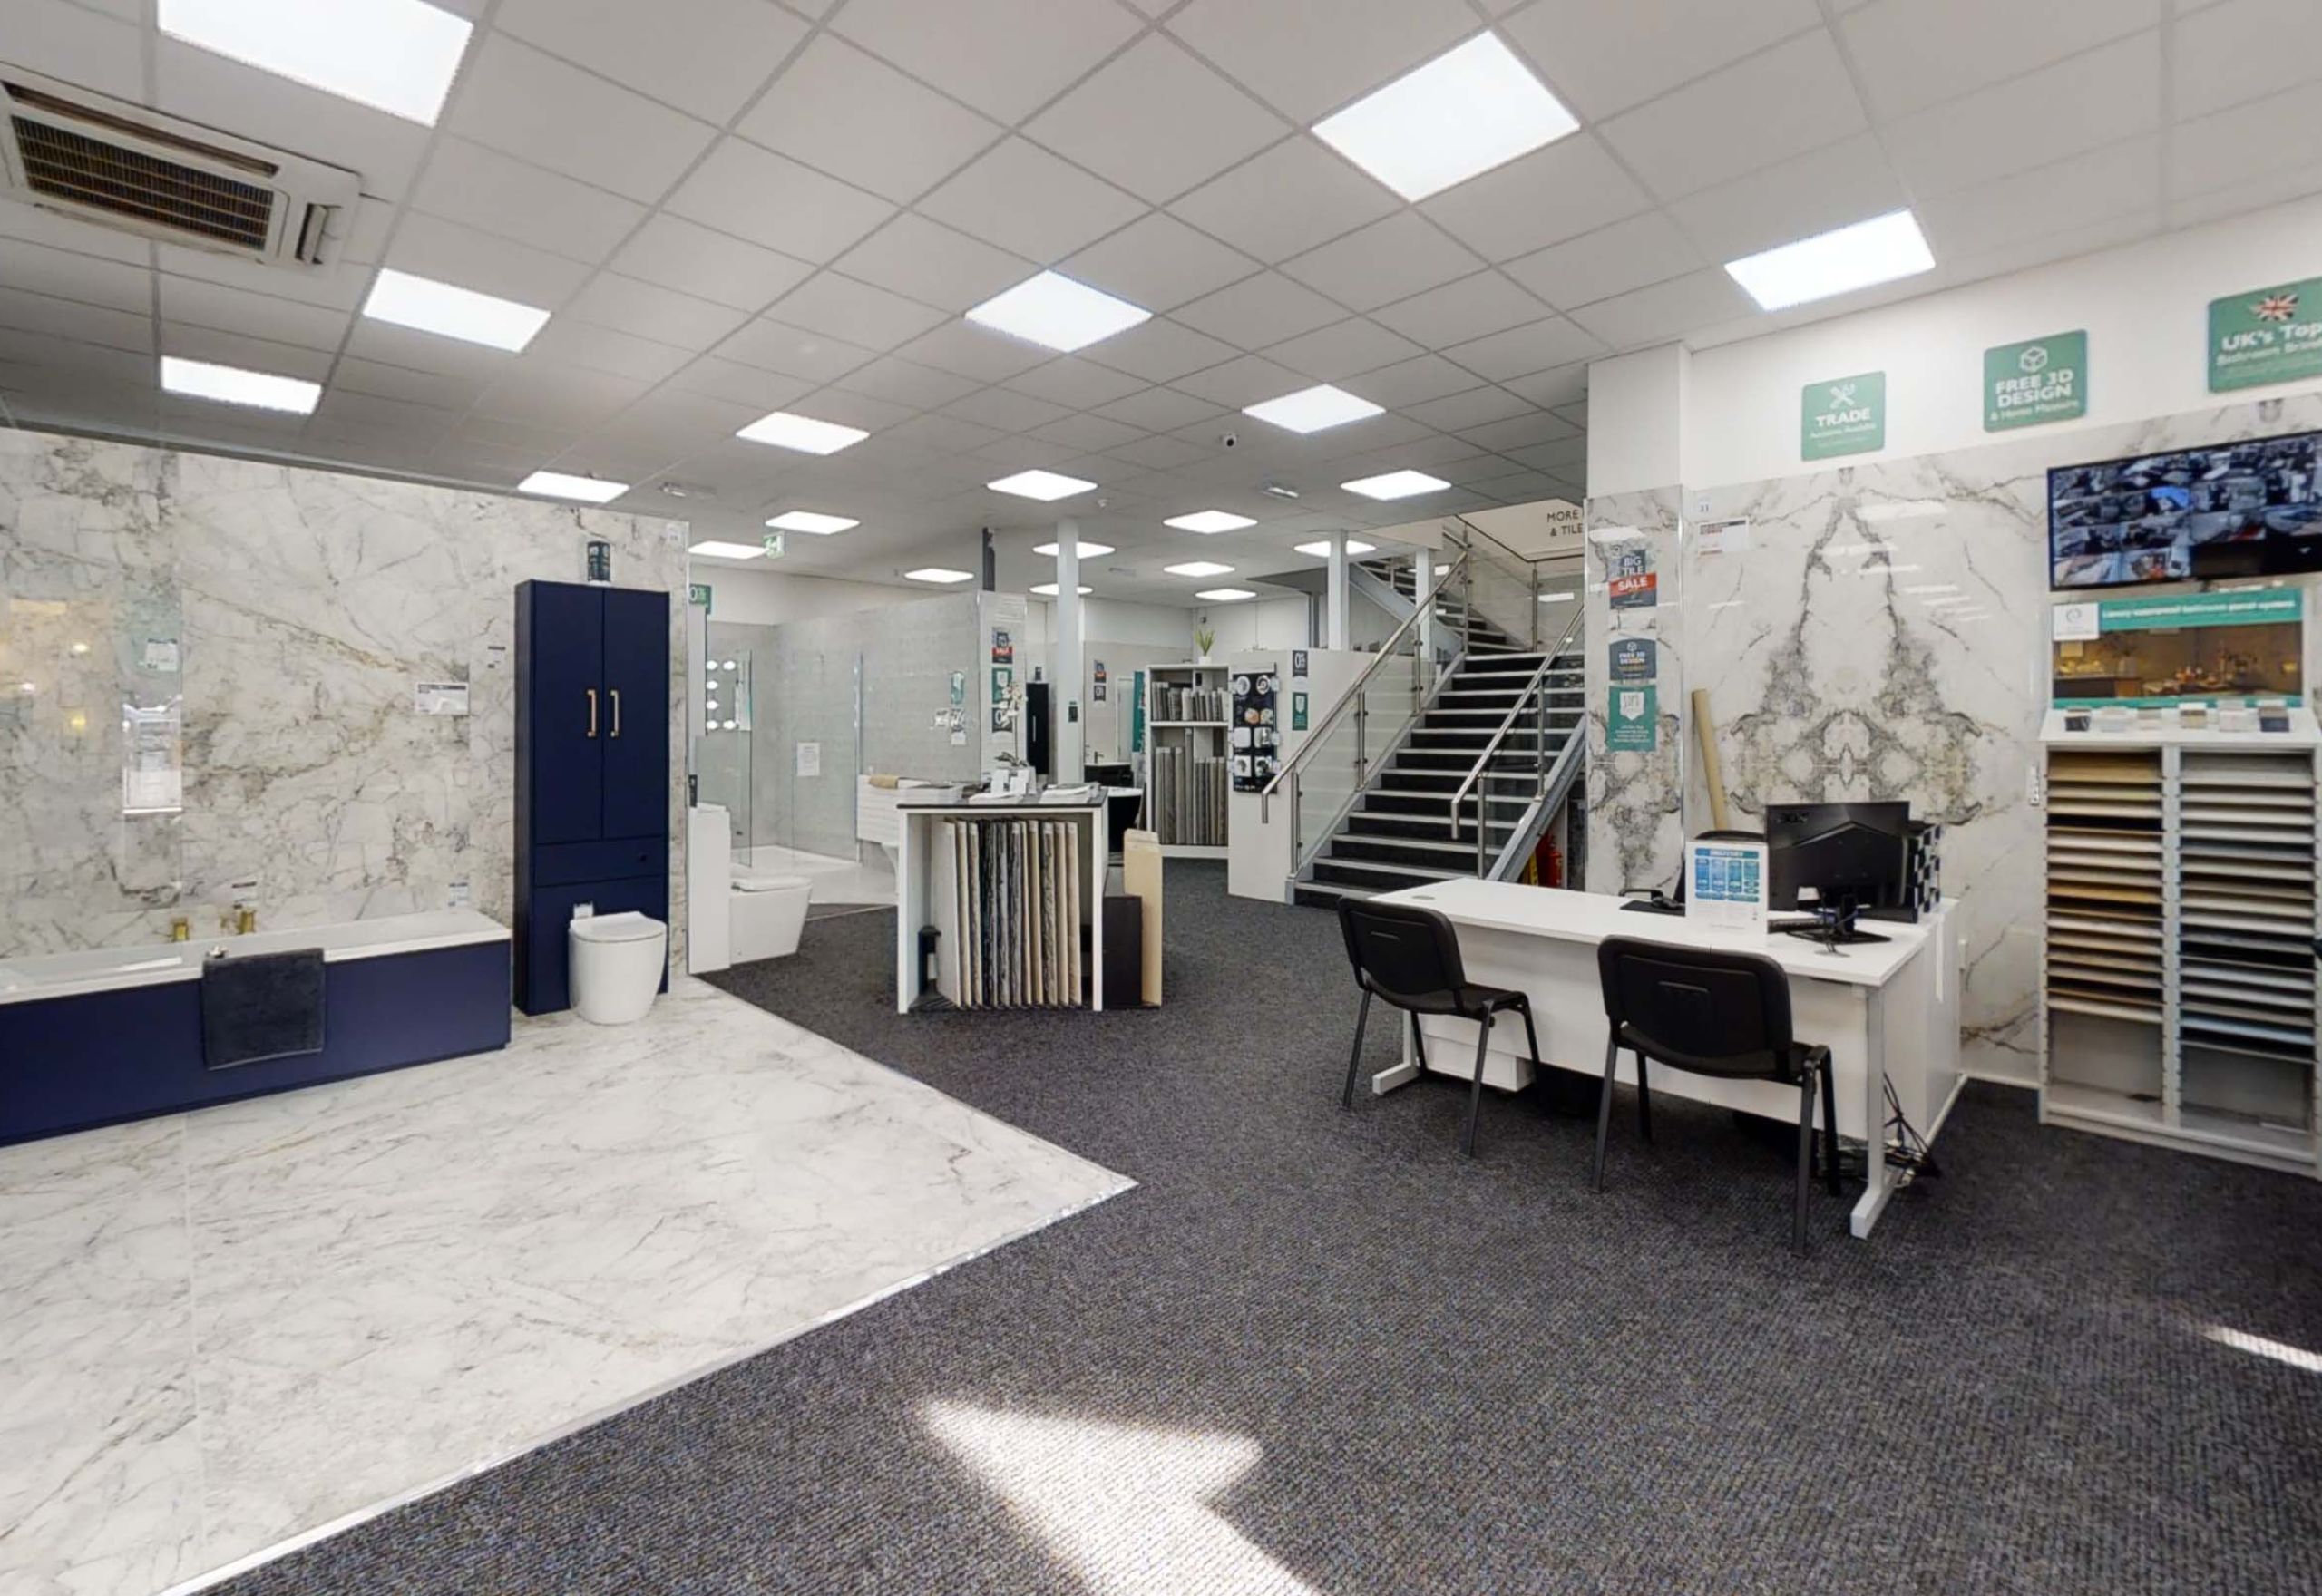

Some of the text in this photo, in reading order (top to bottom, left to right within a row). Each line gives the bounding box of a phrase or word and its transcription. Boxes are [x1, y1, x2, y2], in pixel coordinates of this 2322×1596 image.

[2221, 322, 2322, 351] UK's Top
[1996, 368, 2074, 394] FREE 3D
[1998, 383, 2073, 408] DESIGN
[1815, 407, 1871, 427] TRADE
[1546, 510, 1579, 523] MORE
[1550, 523, 1584, 537] & TILE
[1624, 556, 1642, 567] BIG
[1617, 576, 1649, 592] SALE
